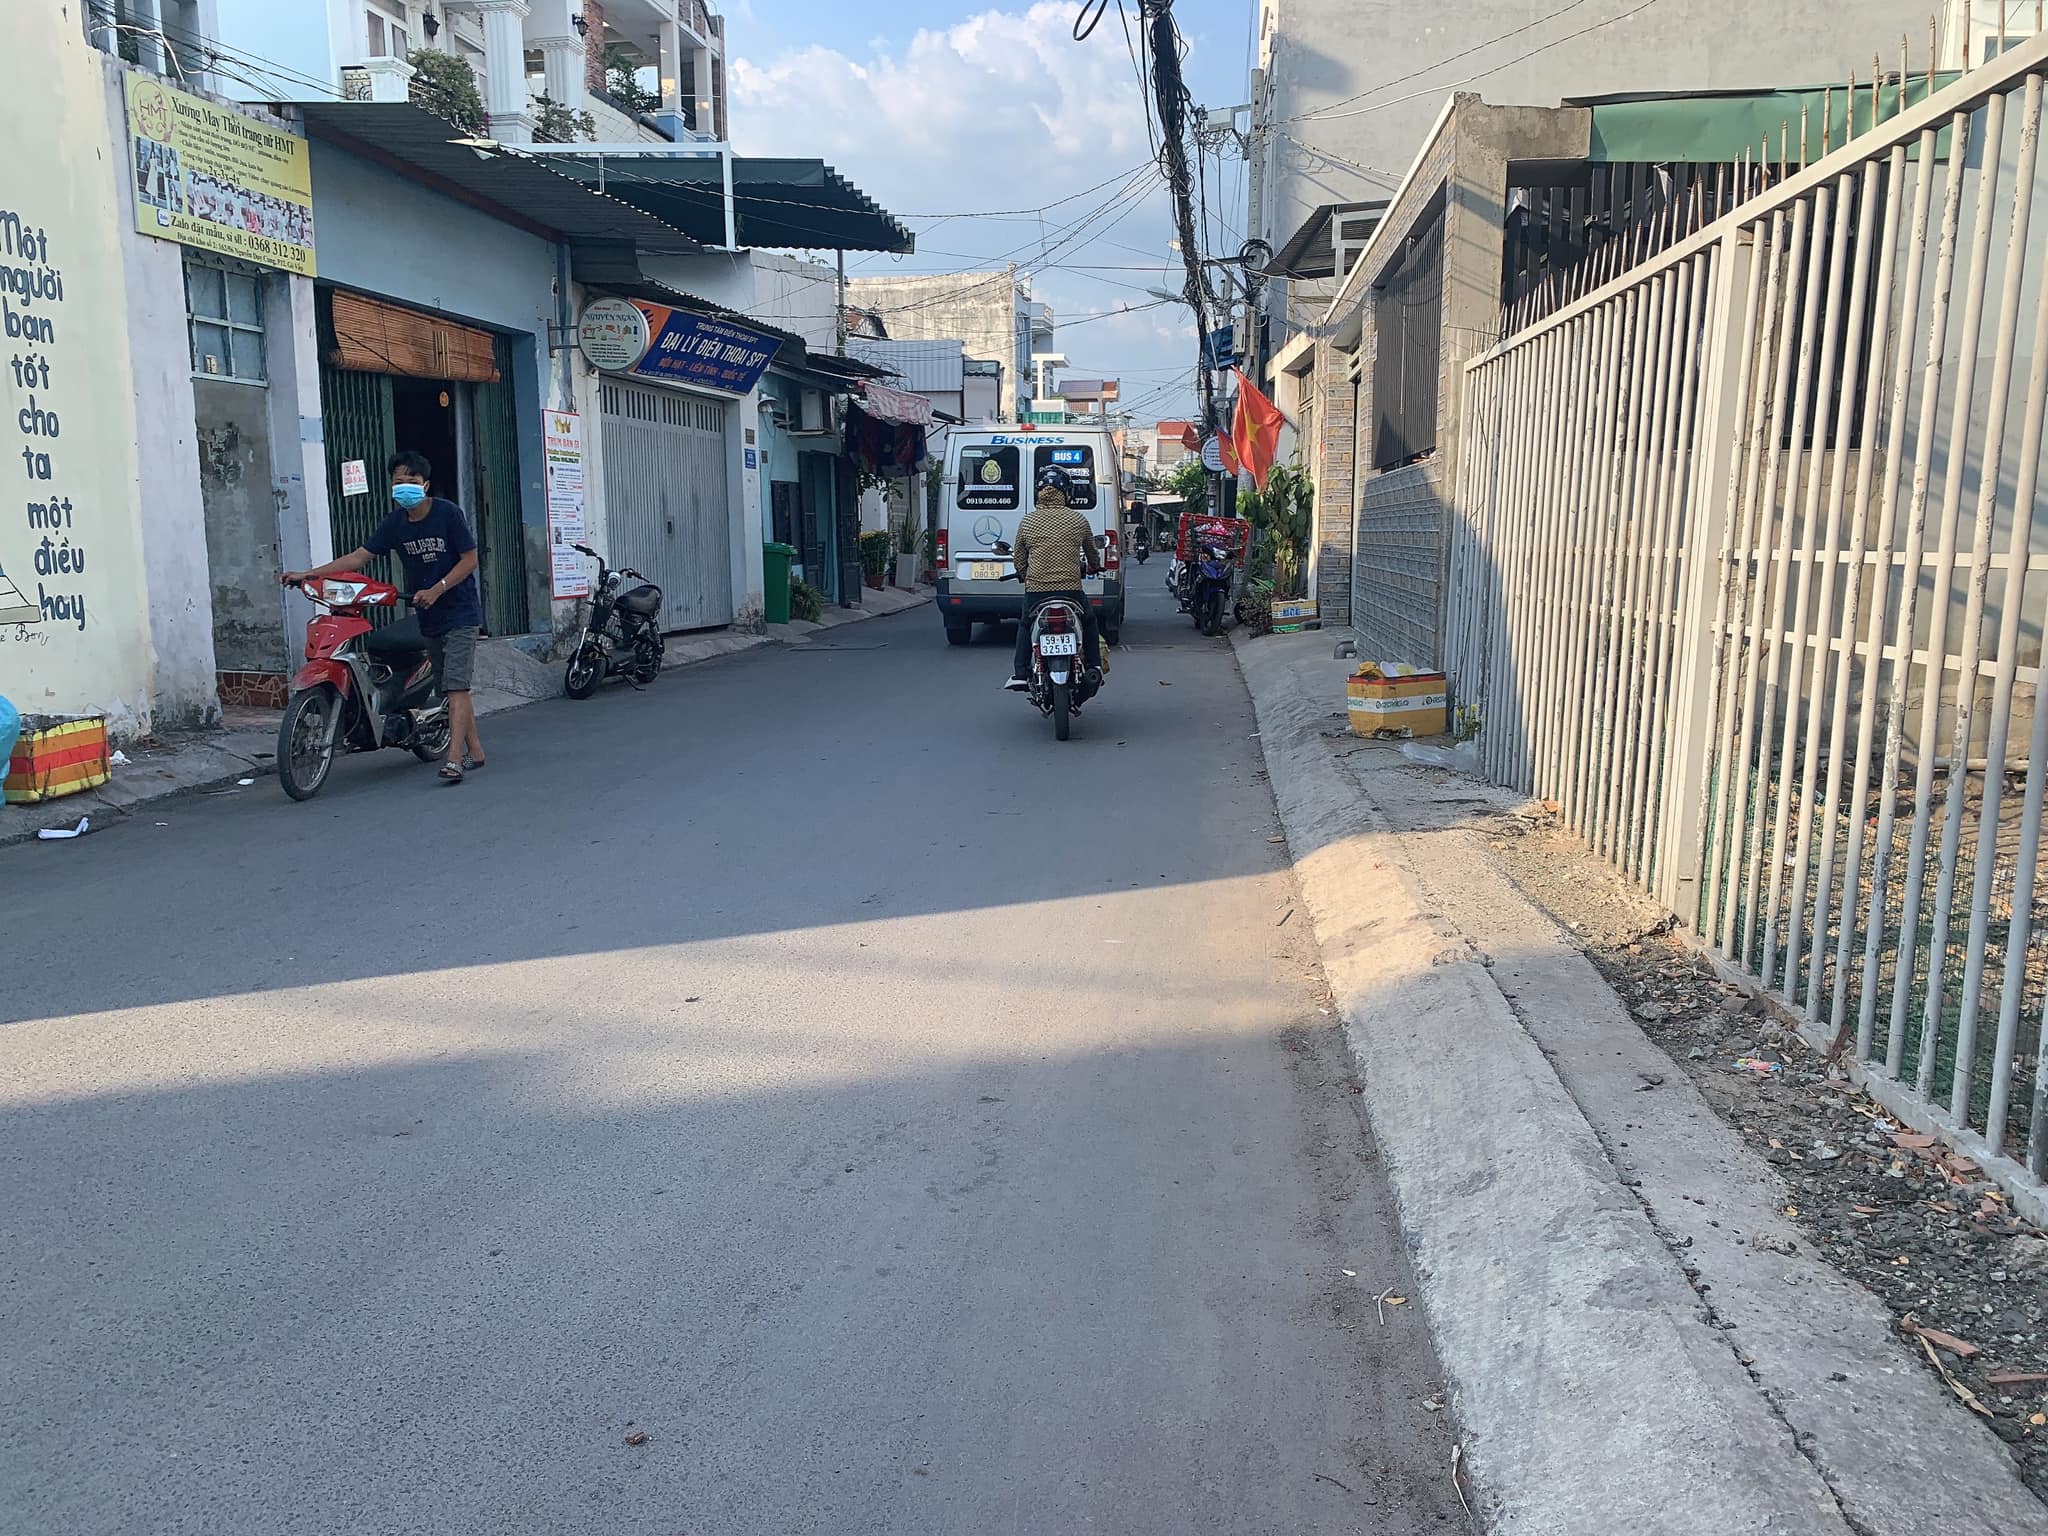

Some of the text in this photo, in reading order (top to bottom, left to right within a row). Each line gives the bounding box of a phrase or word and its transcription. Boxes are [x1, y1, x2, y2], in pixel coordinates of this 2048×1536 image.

[171, 96, 201, 125] Xưởng
[202, 107, 220, 131] May
[242, 125, 262, 148] trang
[275, 135, 295, 155] HMT
[0, 210, 47, 267] Một
[171, 215, 190, 230] Zalo
[191, 221, 204, 236] đặt
[248, 235, 271, 253] 0368
[272, 242, 288, 258] 312
[290, 247, 306, 262] 320
[0, 265, 63, 307] người
[3, 296, 54, 347] bạn
[660, 331, 768, 368] ĐẠI LÝ ĐIỆN THOẠI SPT
[11, 353, 49, 390] tốt
[19, 394, 59, 437] cho
[23, 445, 51, 480] ta
[1054, 452, 1081, 461] BUS 4
[27, 495, 72, 535] một
[34, 535, 84, 576] điều
[38, 582, 85, 631] hay
[1042, 645, 1073, 655] 325.61
[1045, 636, 1071, 645] 59-V3
